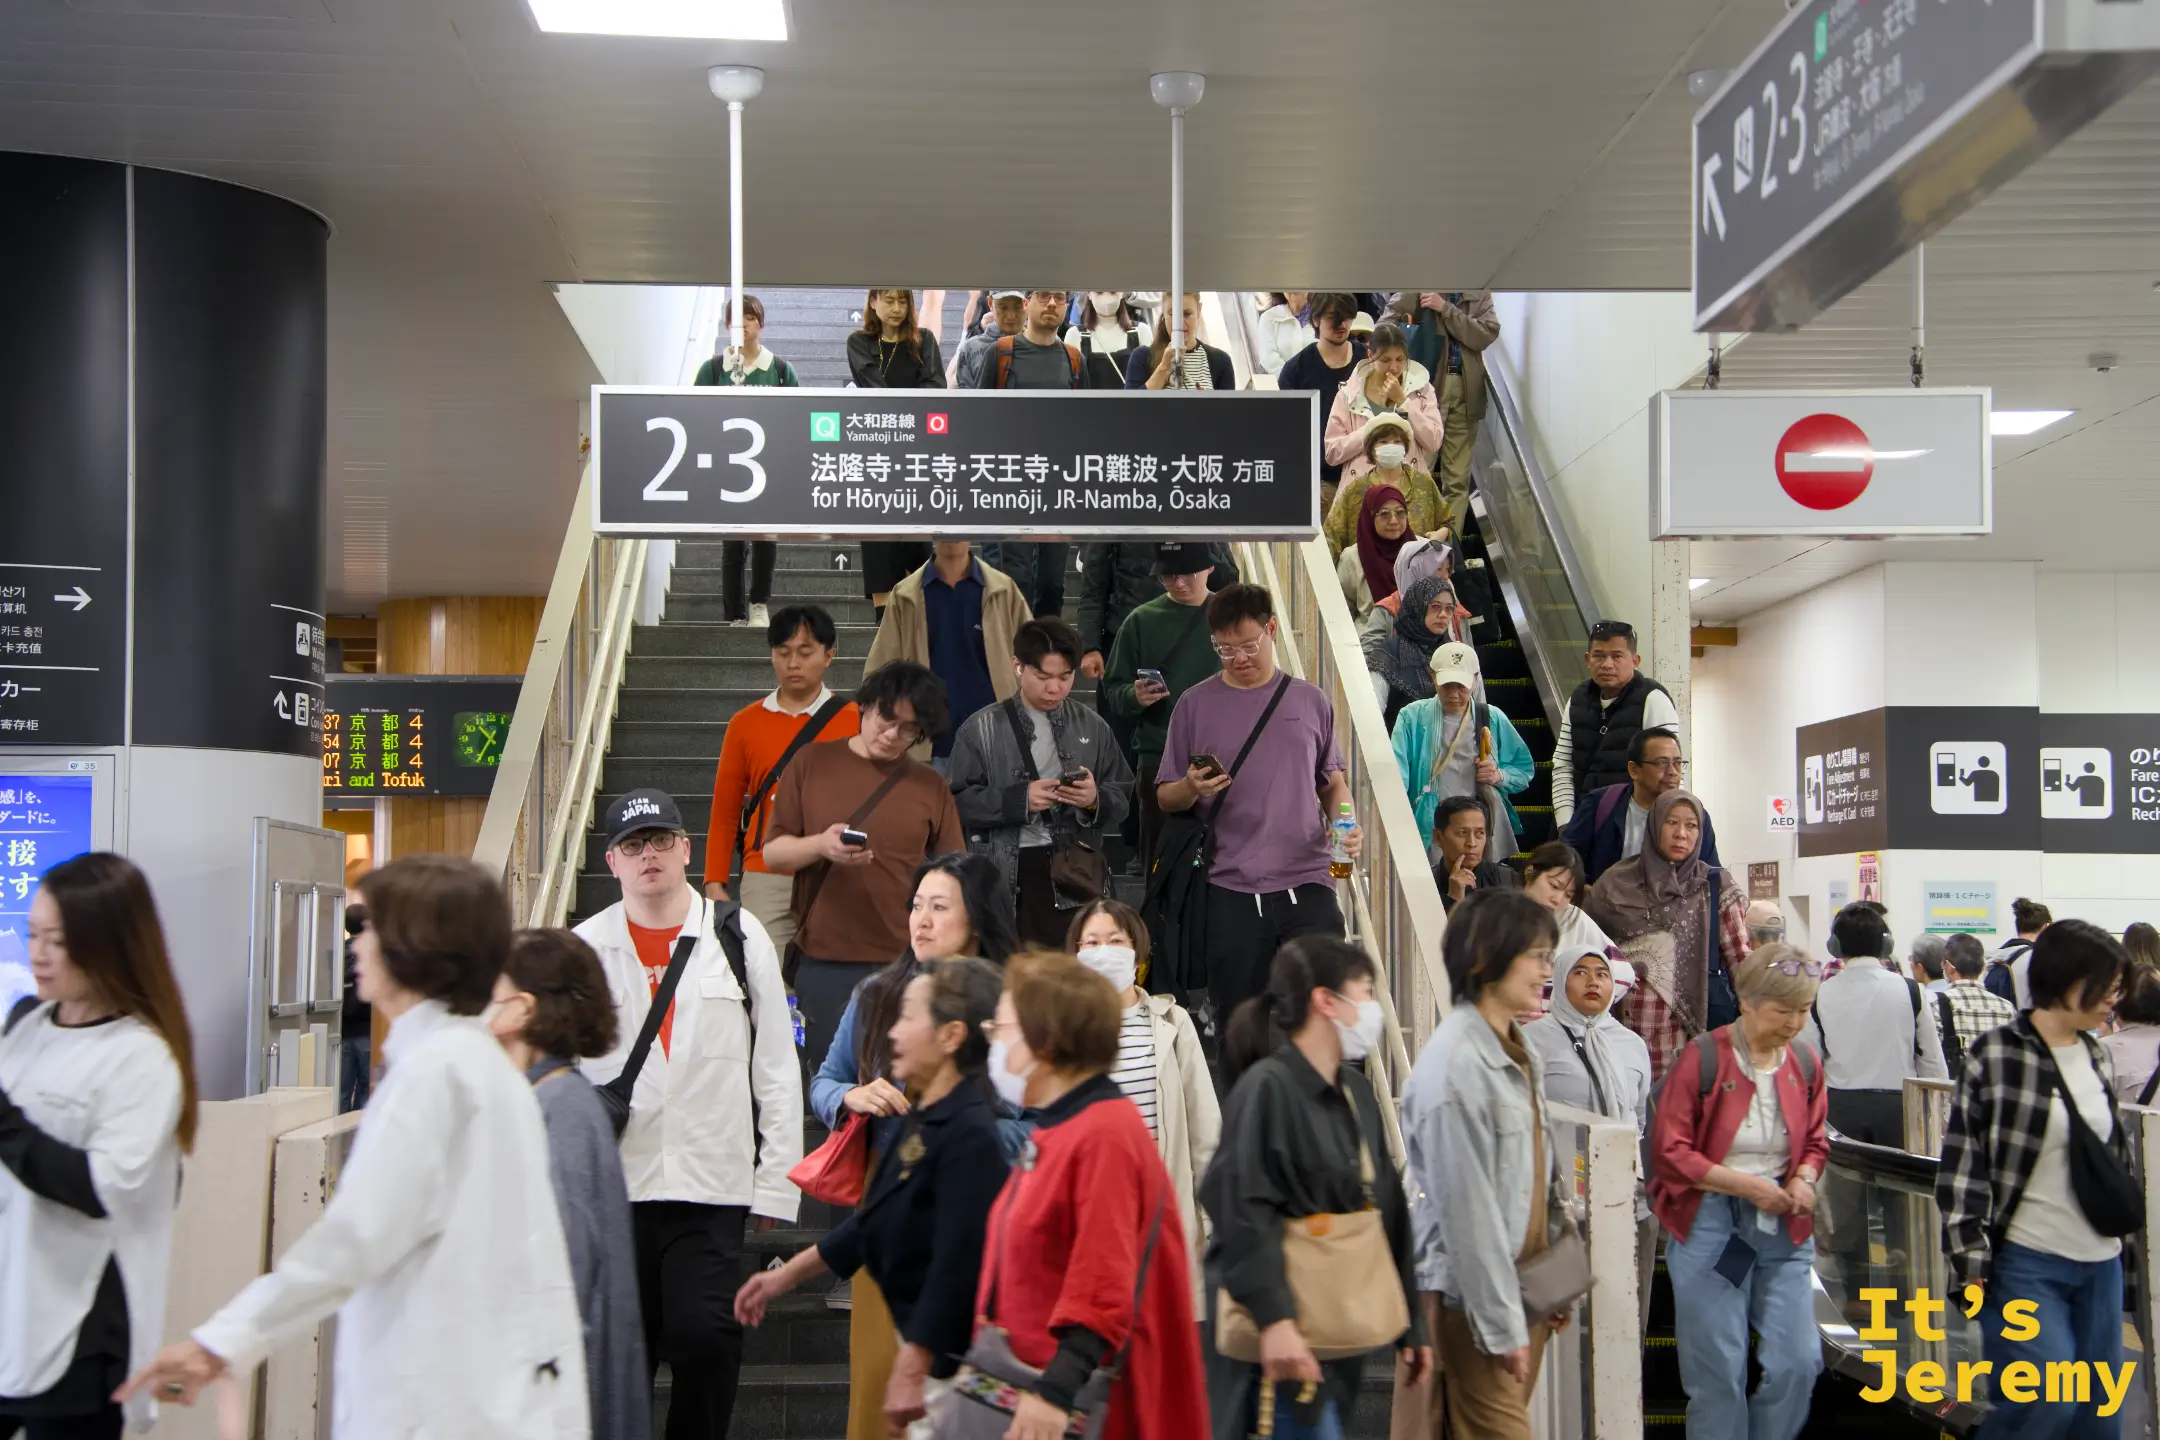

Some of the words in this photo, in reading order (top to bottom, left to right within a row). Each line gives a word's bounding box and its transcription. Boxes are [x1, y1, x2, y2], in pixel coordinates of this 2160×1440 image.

[815, 416, 836, 438] Q
[846, 412, 916, 429] 大和路線
[846, 430, 891, 444] Yamatoji
[894, 431, 916, 442] Line
[1232, 459, 1275, 483] 方面
[811, 486, 841, 508] for
[847, 487, 923, 514] Hōryūji,
[930, 485, 963, 514] Ōji,
[970, 488, 1048, 514] Tennōji,
[1054, 488, 1162, 512] JR-Namba,
[1169, 485, 1231, 509] Ōsaka
[0, 586, 26, 599] 산기
[0, 642, 42, 654] 卡充值
[1, 680, 41, 697] カー
[1, 719, 39, 731] 寄存柜
[409, 715, 424, 730] 4
[409, 734, 424, 749] 4
[409, 753, 424, 768] 4
[349, 772, 375, 787] and
[382, 772, 426, 787] Tofuk
[2131, 769, 2159, 782] Fare
[628, 797, 649, 807] TEAM
[2131, 786, 2160, 804] IC
[621, 803, 660, 821] JAPAN
[1771, 817, 1795, 826] AED
[0, 839, 37, 867] 接
